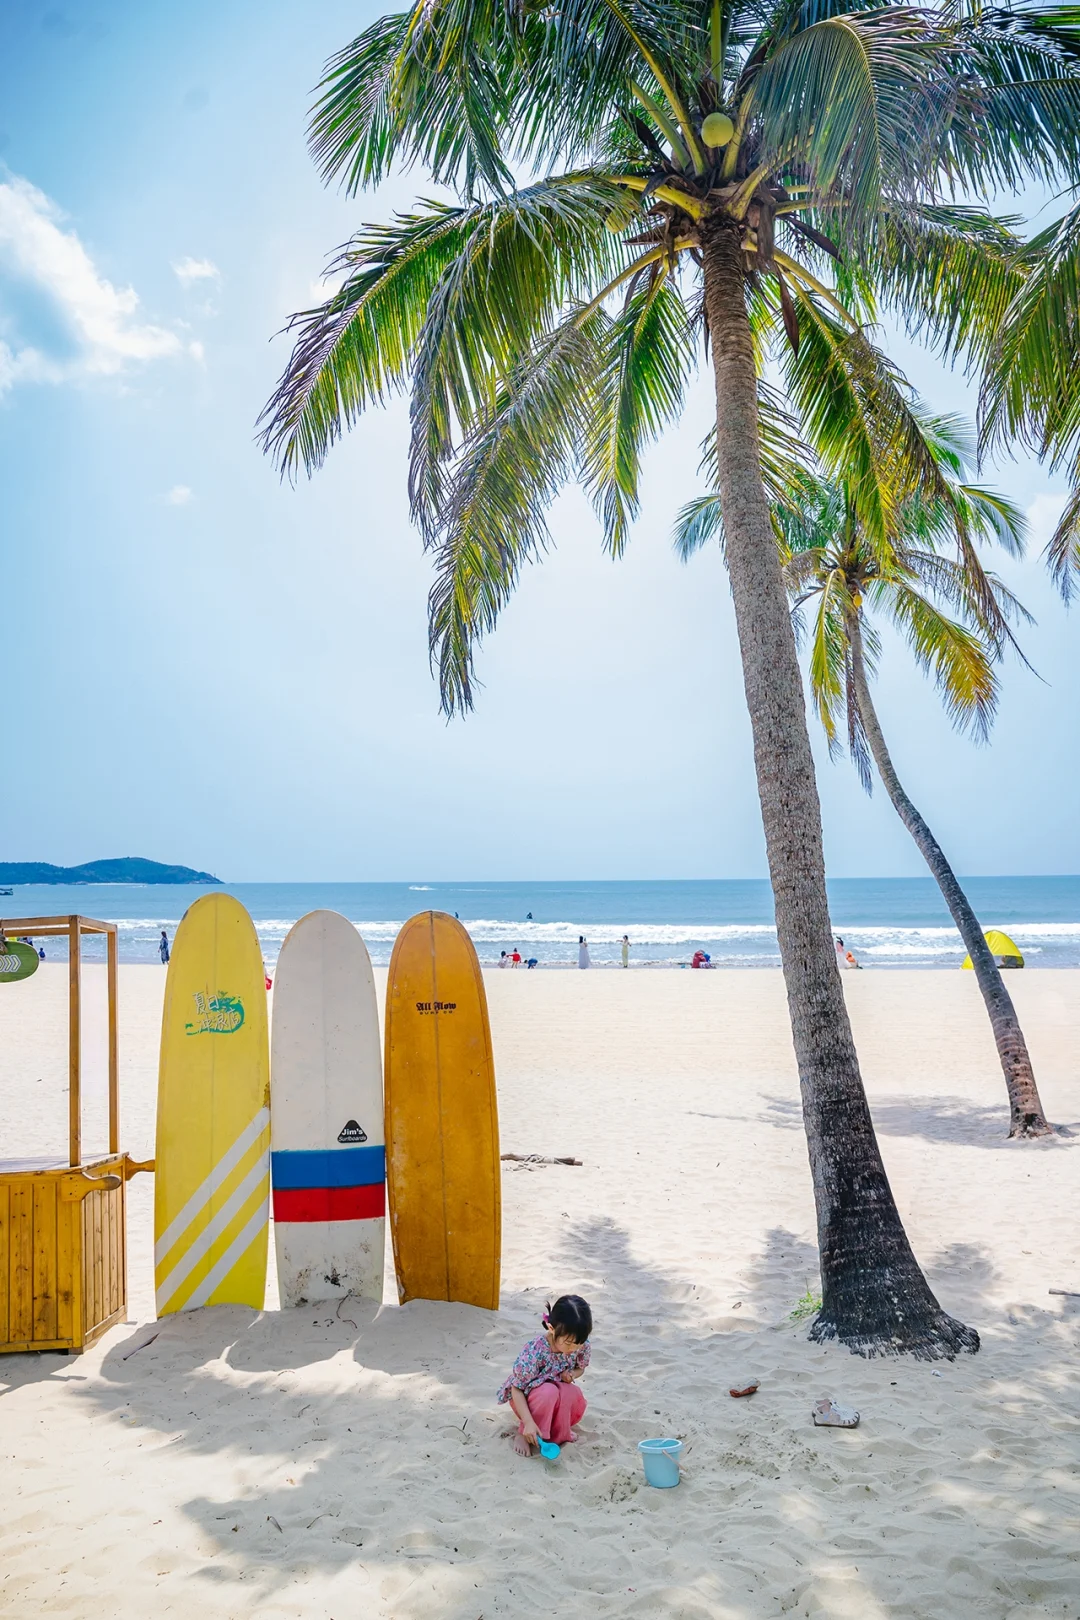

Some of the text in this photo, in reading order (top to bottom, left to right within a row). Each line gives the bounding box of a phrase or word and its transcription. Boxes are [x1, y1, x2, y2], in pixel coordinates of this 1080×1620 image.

[192, 991, 219, 1015] 夏日
[416, 1002, 431, 1011] All
[197, 1007, 240, 1033] 冲浪店
